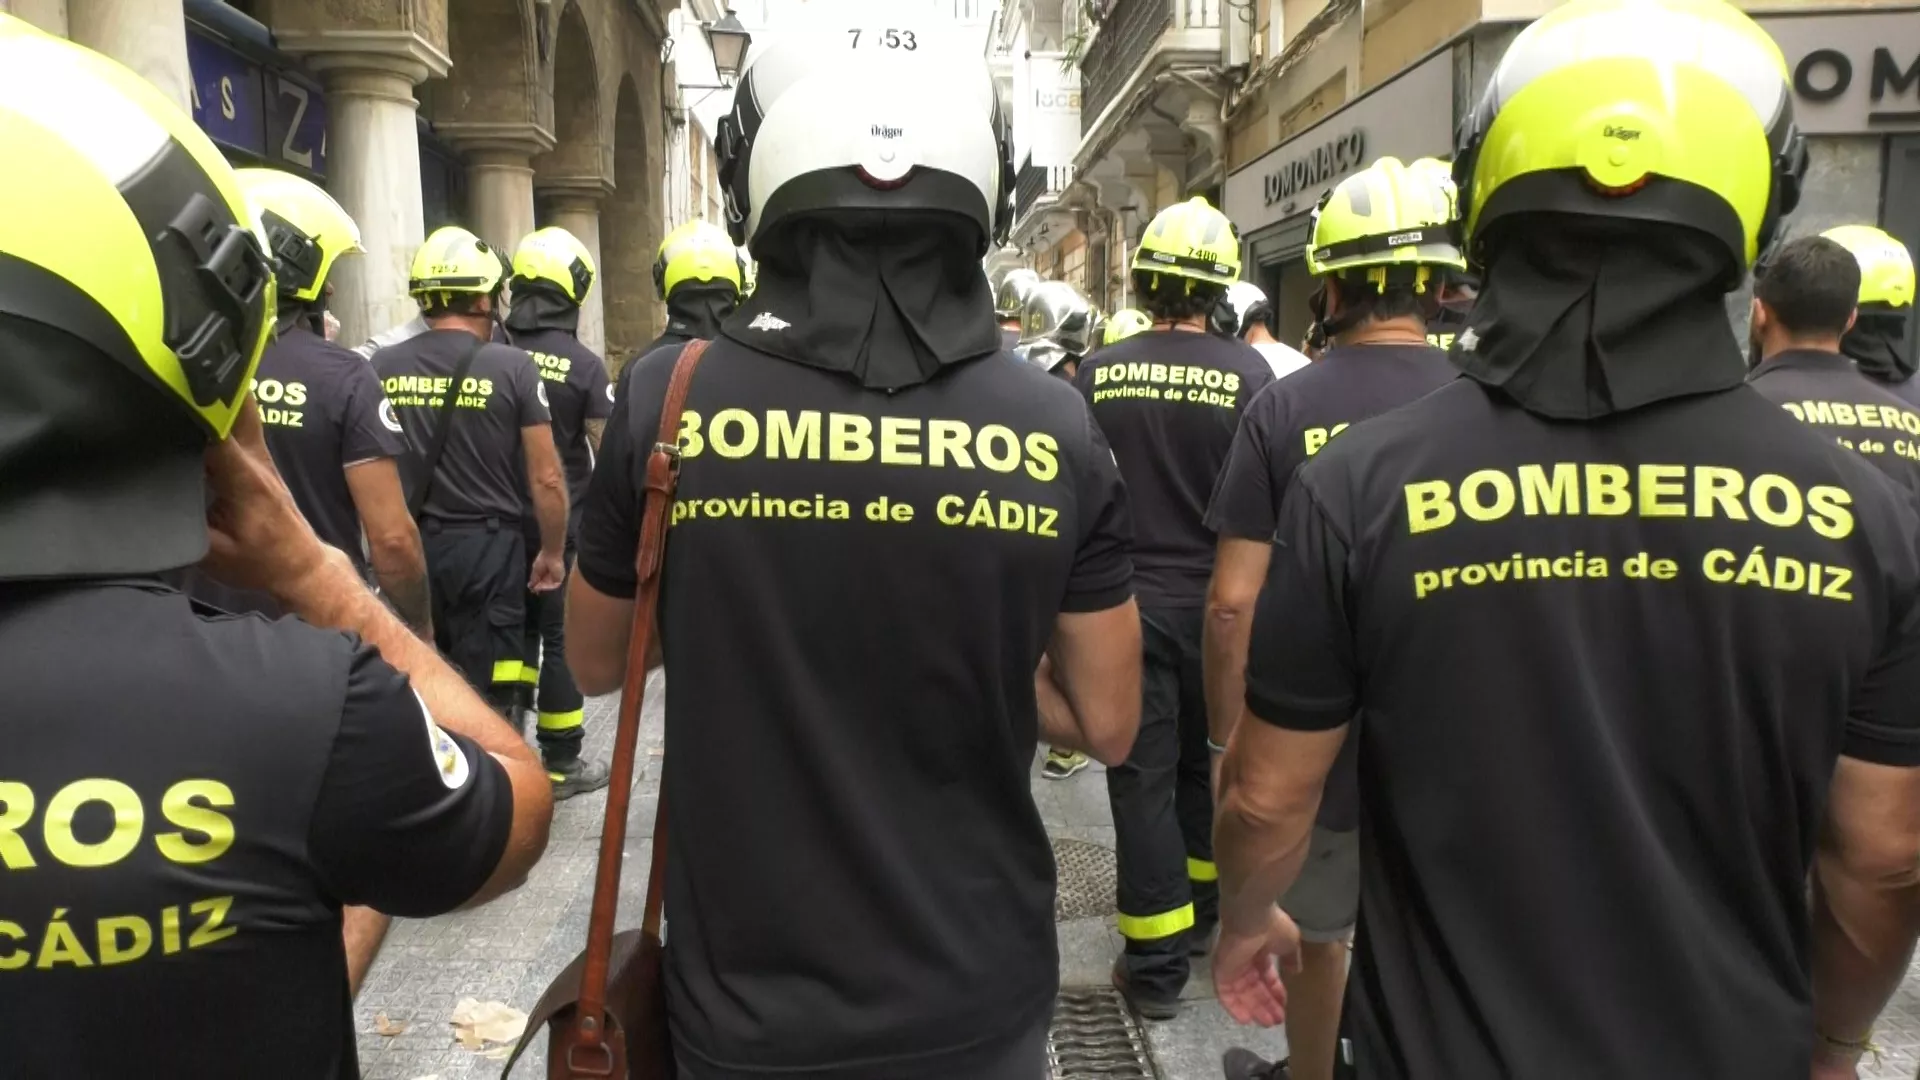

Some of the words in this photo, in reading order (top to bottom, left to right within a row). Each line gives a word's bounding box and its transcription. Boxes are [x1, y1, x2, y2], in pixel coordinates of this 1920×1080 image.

[847, 28, 918, 51] 753
[278, 77, 326, 170] Z
[1264, 127, 1366, 207] LOMONACO
[525, 349, 571, 372] ROS
[1094, 362, 1240, 392] BOMBEROS
[380, 375, 493, 396] OMBEOS
[1094, 386, 1159, 403] provincia
[1164, 388, 1183, 401] de
[1187, 388, 1236, 408] CÁDIZ
[677, 408, 1059, 482] BOMBEROS
[671, 492, 850, 526] provincia
[865, 496, 915, 522] de
[937, 491, 1059, 538] CÁDIZ
[1403, 463, 1855, 540] BOMBEROS
[1413, 551, 1609, 599] provincia
[1622, 552, 1679, 580] de
[1702, 547, 1853, 602] CÁDIZ
